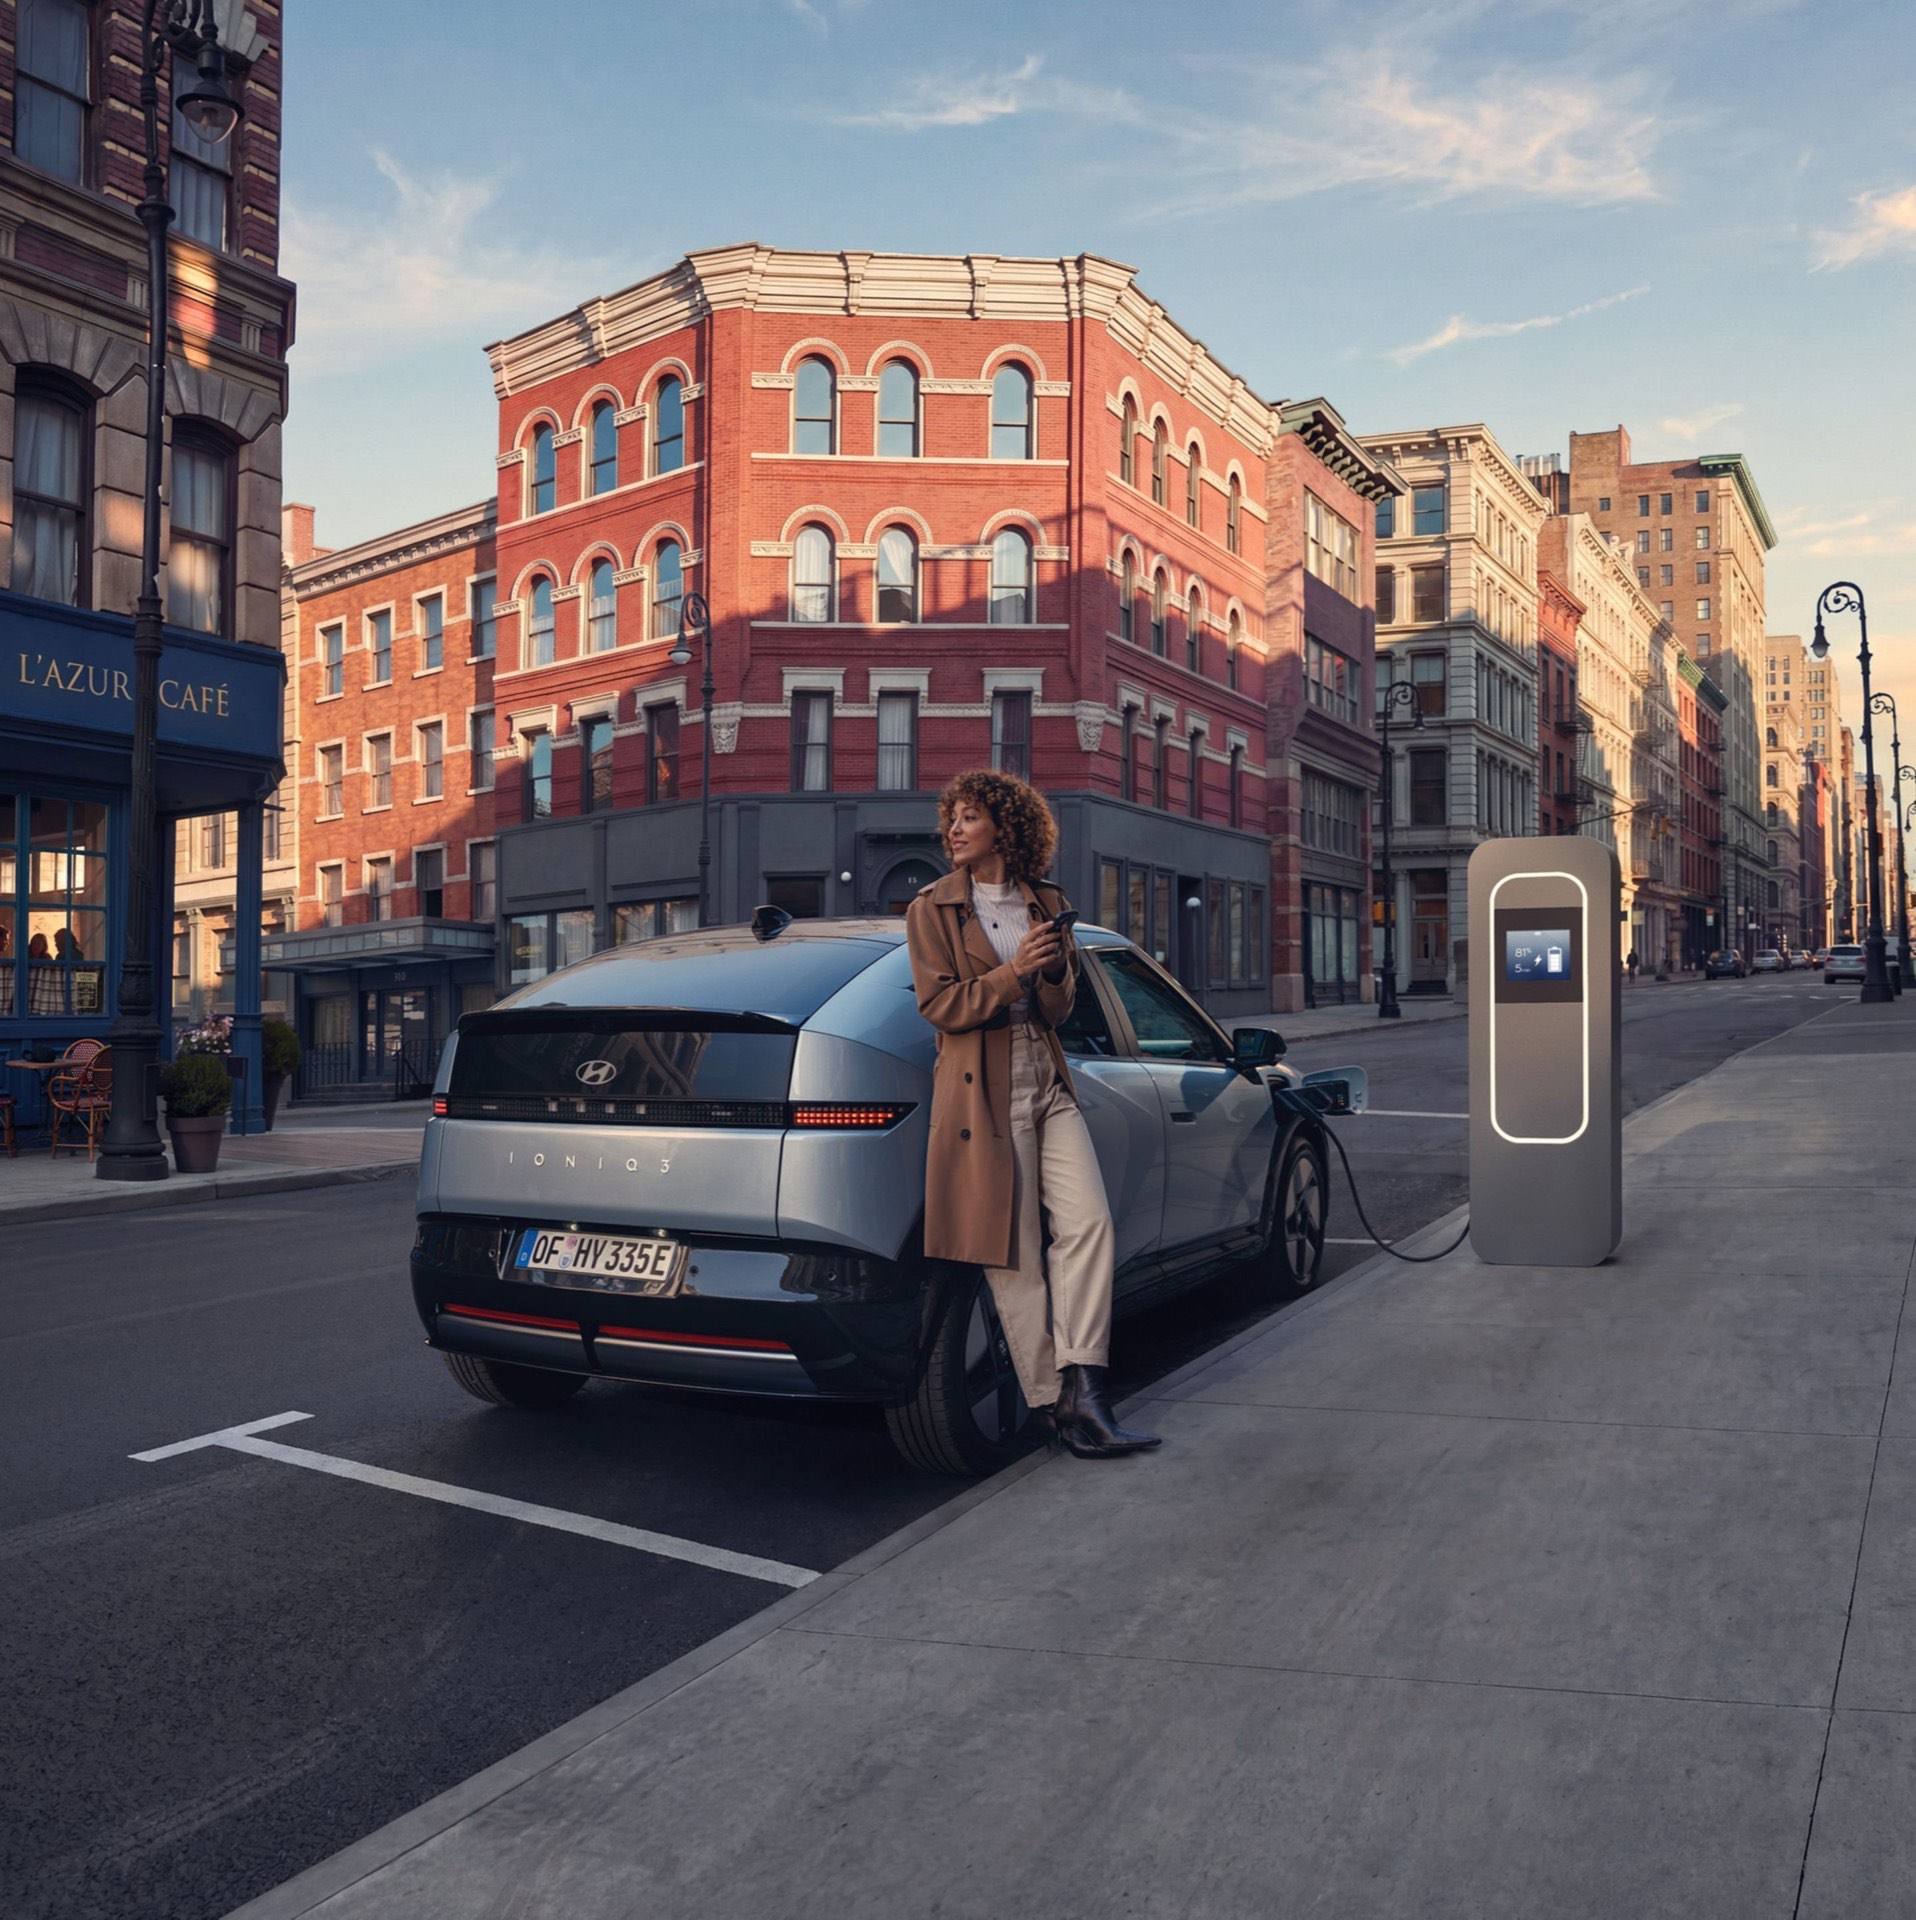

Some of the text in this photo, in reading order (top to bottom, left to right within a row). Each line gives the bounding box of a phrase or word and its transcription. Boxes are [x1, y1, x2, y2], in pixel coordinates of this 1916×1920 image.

[19, 653, 230, 717] L'AZUR CAFÉ
[509, 1152, 670, 1173] IONIQ 3
